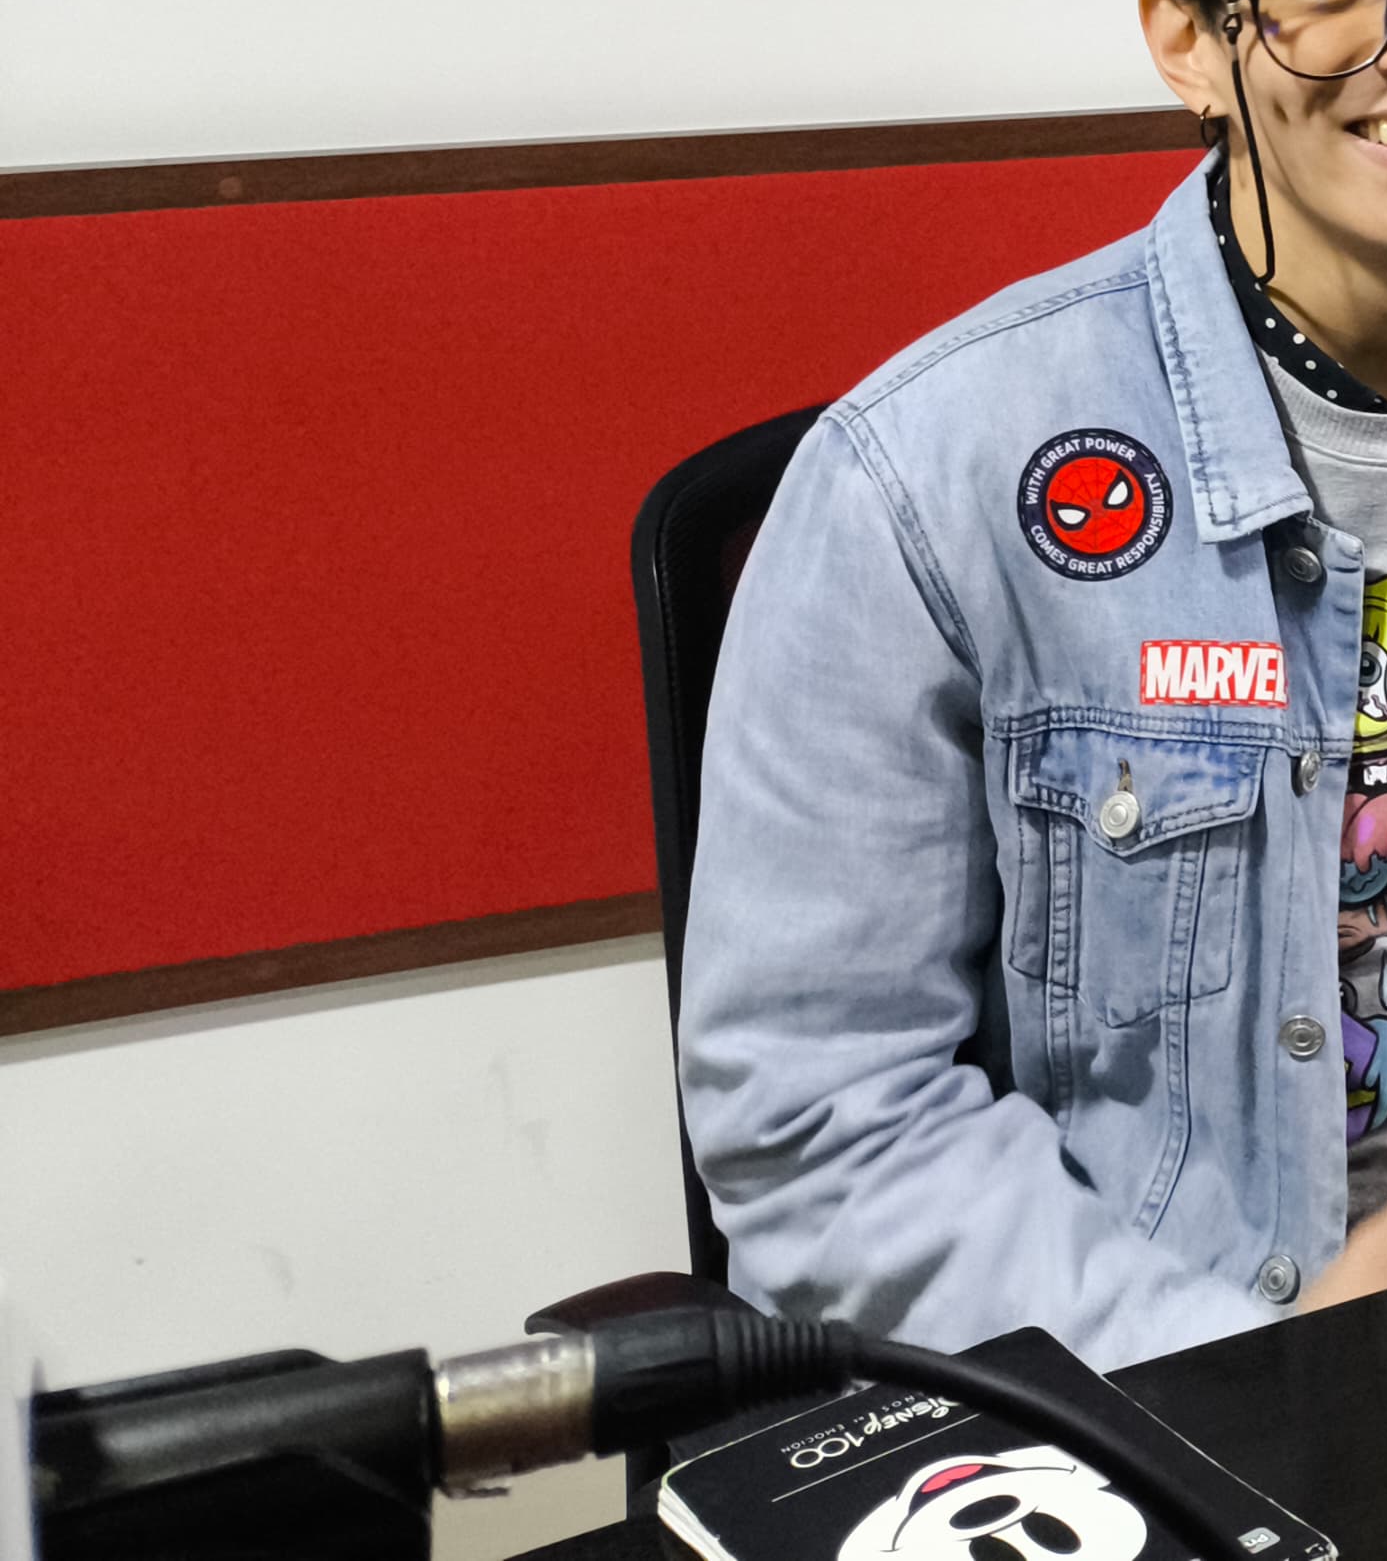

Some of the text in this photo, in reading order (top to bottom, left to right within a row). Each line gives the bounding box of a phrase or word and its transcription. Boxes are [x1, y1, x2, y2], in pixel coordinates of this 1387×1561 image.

[1025, 437, 1137, 505] WITH GREAT POWER
[1030, 471, 1165, 575] COMES GREAT RESPONSIBILITY
[1145, 645, 1288, 704] MARVEL
[790, 1431, 865, 1469] 100
